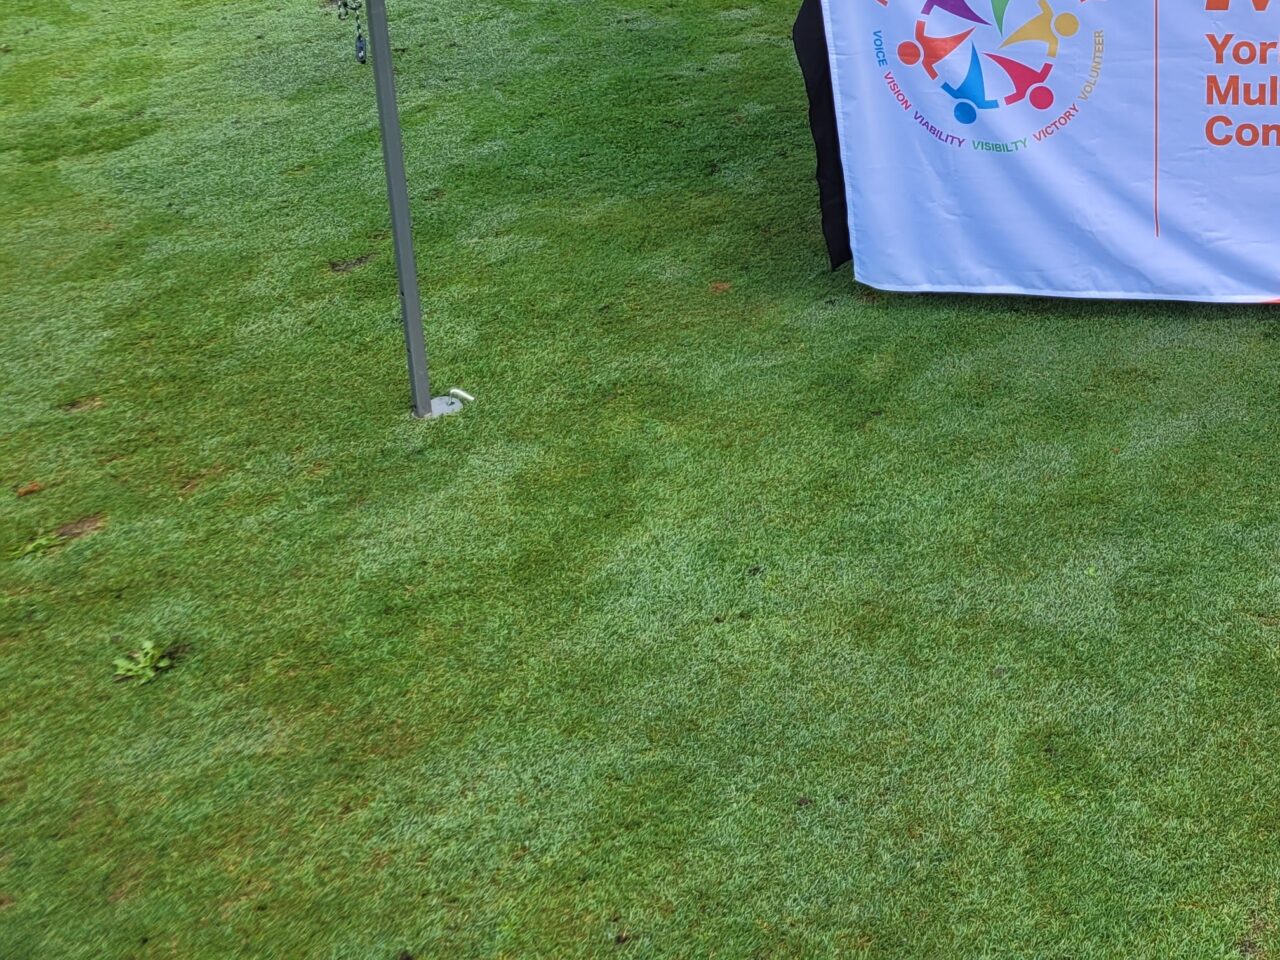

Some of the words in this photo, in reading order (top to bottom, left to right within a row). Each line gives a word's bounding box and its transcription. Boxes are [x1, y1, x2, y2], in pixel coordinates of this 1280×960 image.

[872, 29, 888, 67] VOICE
[884, 71, 911, 111] VISION
[913, 110, 965, 148] VIABILITY
[1032, 103, 1080, 142] VICTORY
[1077, 29, 1104, 102] VOLUNTEER
